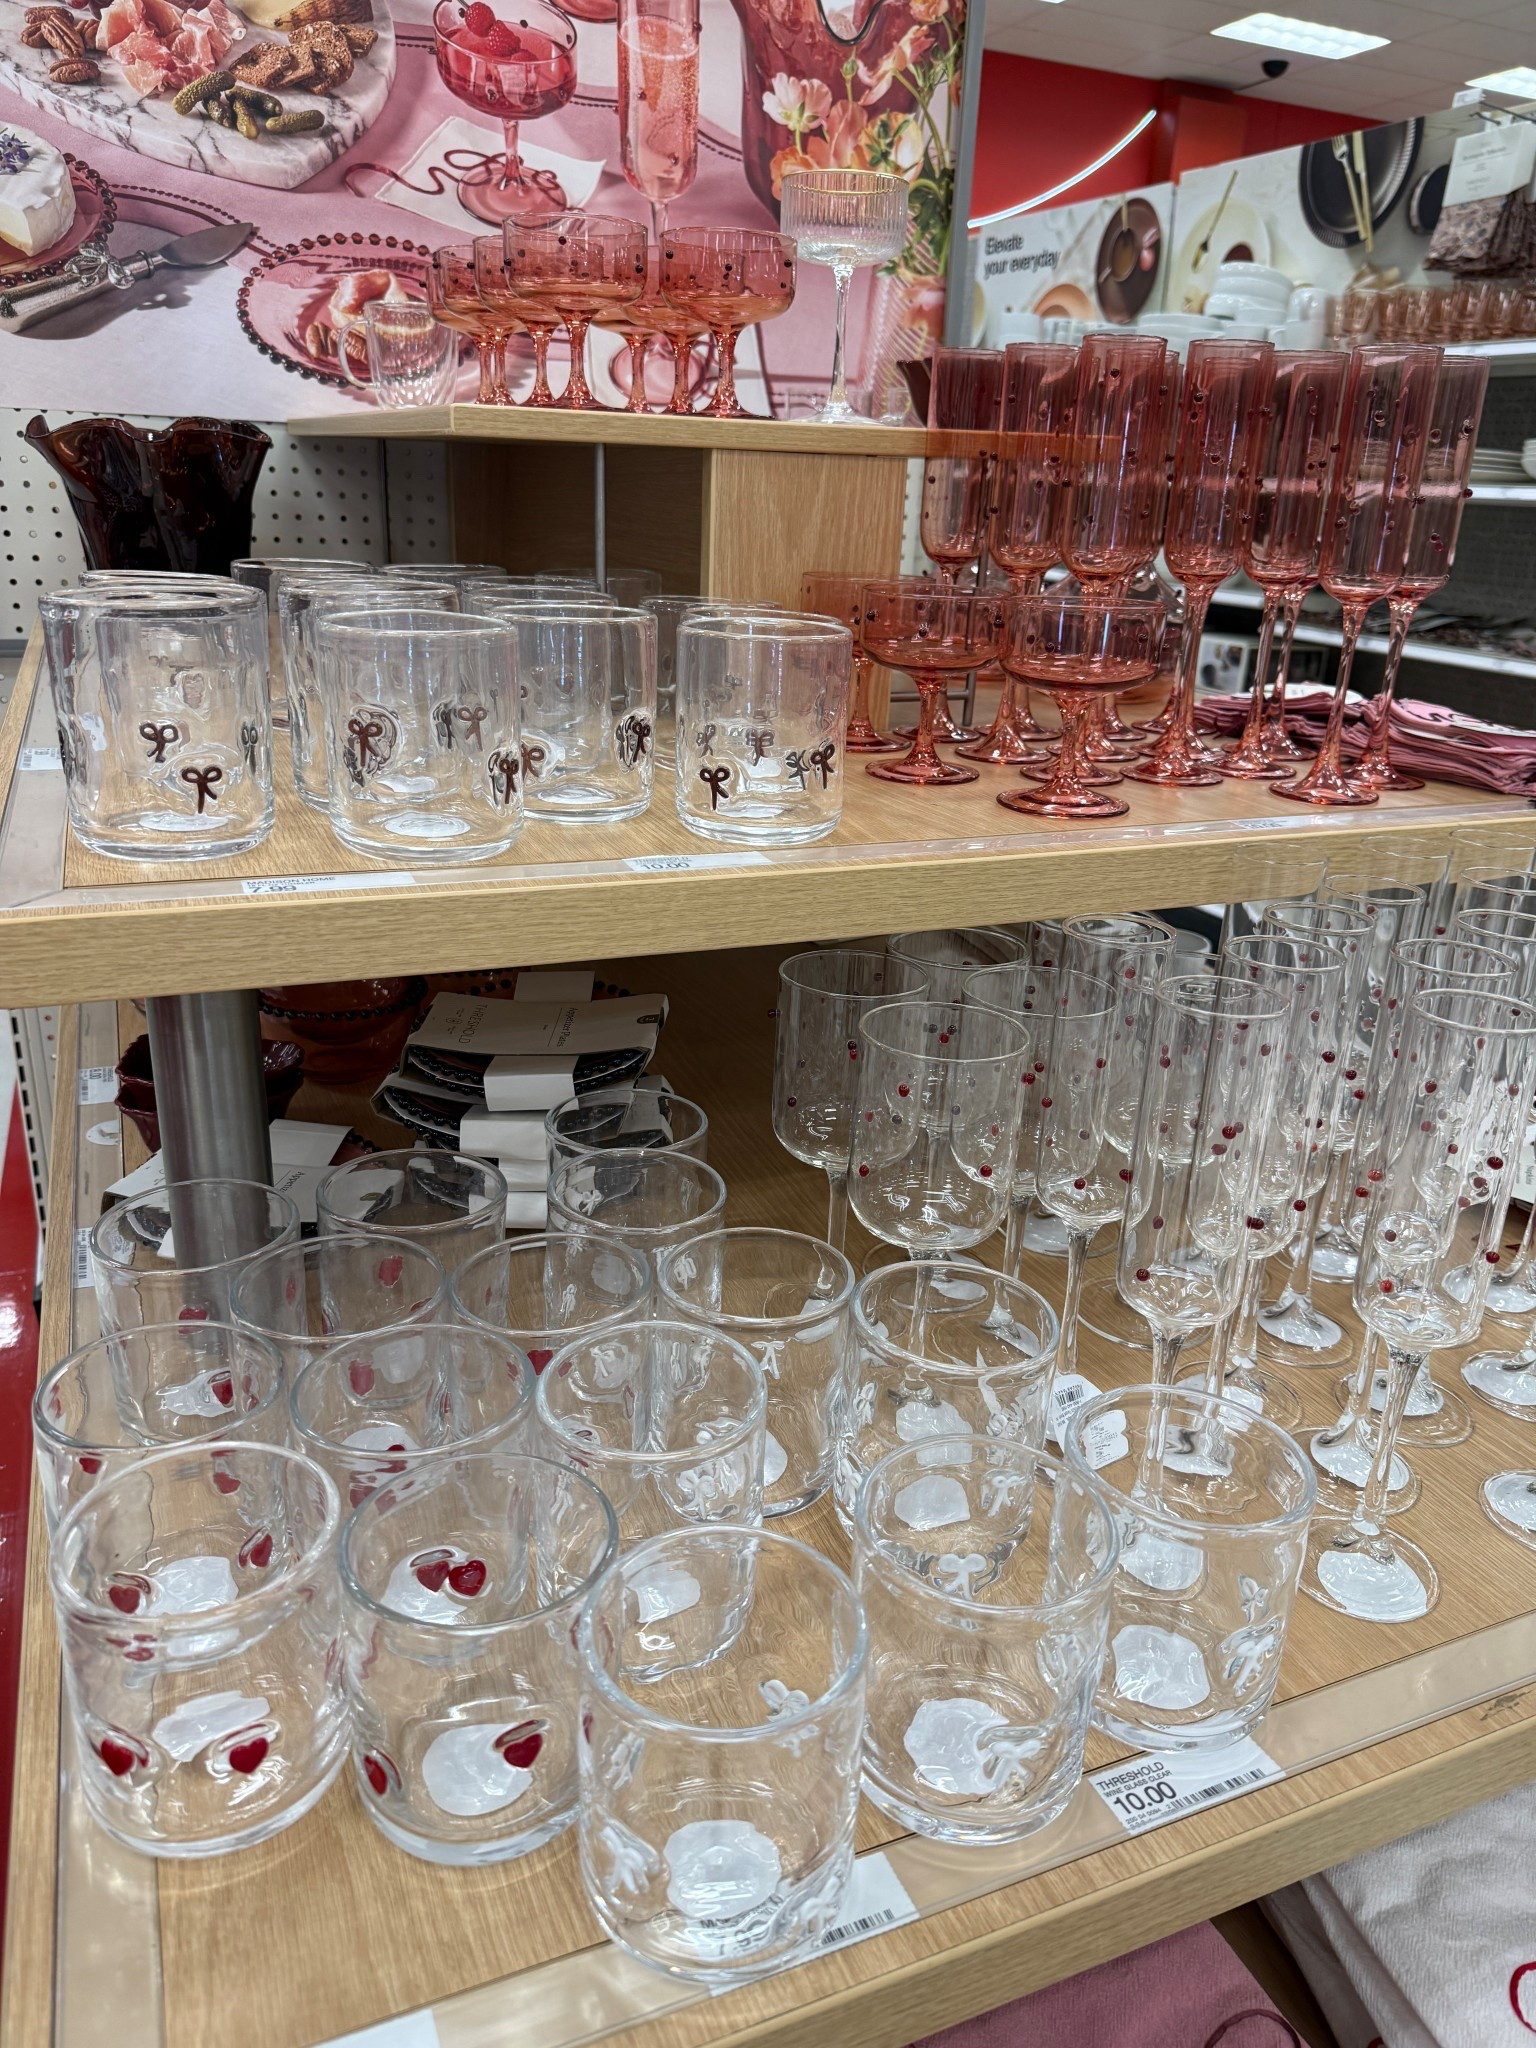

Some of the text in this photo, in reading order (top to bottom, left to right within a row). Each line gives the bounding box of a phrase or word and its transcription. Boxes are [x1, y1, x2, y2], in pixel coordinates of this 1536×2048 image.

[984, 250, 1061, 281] your everyday
[642, 862, 690, 870] 10.00
[250, 885, 297, 893] 7.99
[459, 1004, 488, 1043] THRESHOLD
[563, 1007, 579, 1031] Appetizer
[1096, 1762, 1164, 1790] THRESHOLD
[1104, 1770, 1172, 1797] WINE GLASS CLEAR
[1114, 1782, 1176, 1814] 10.00
